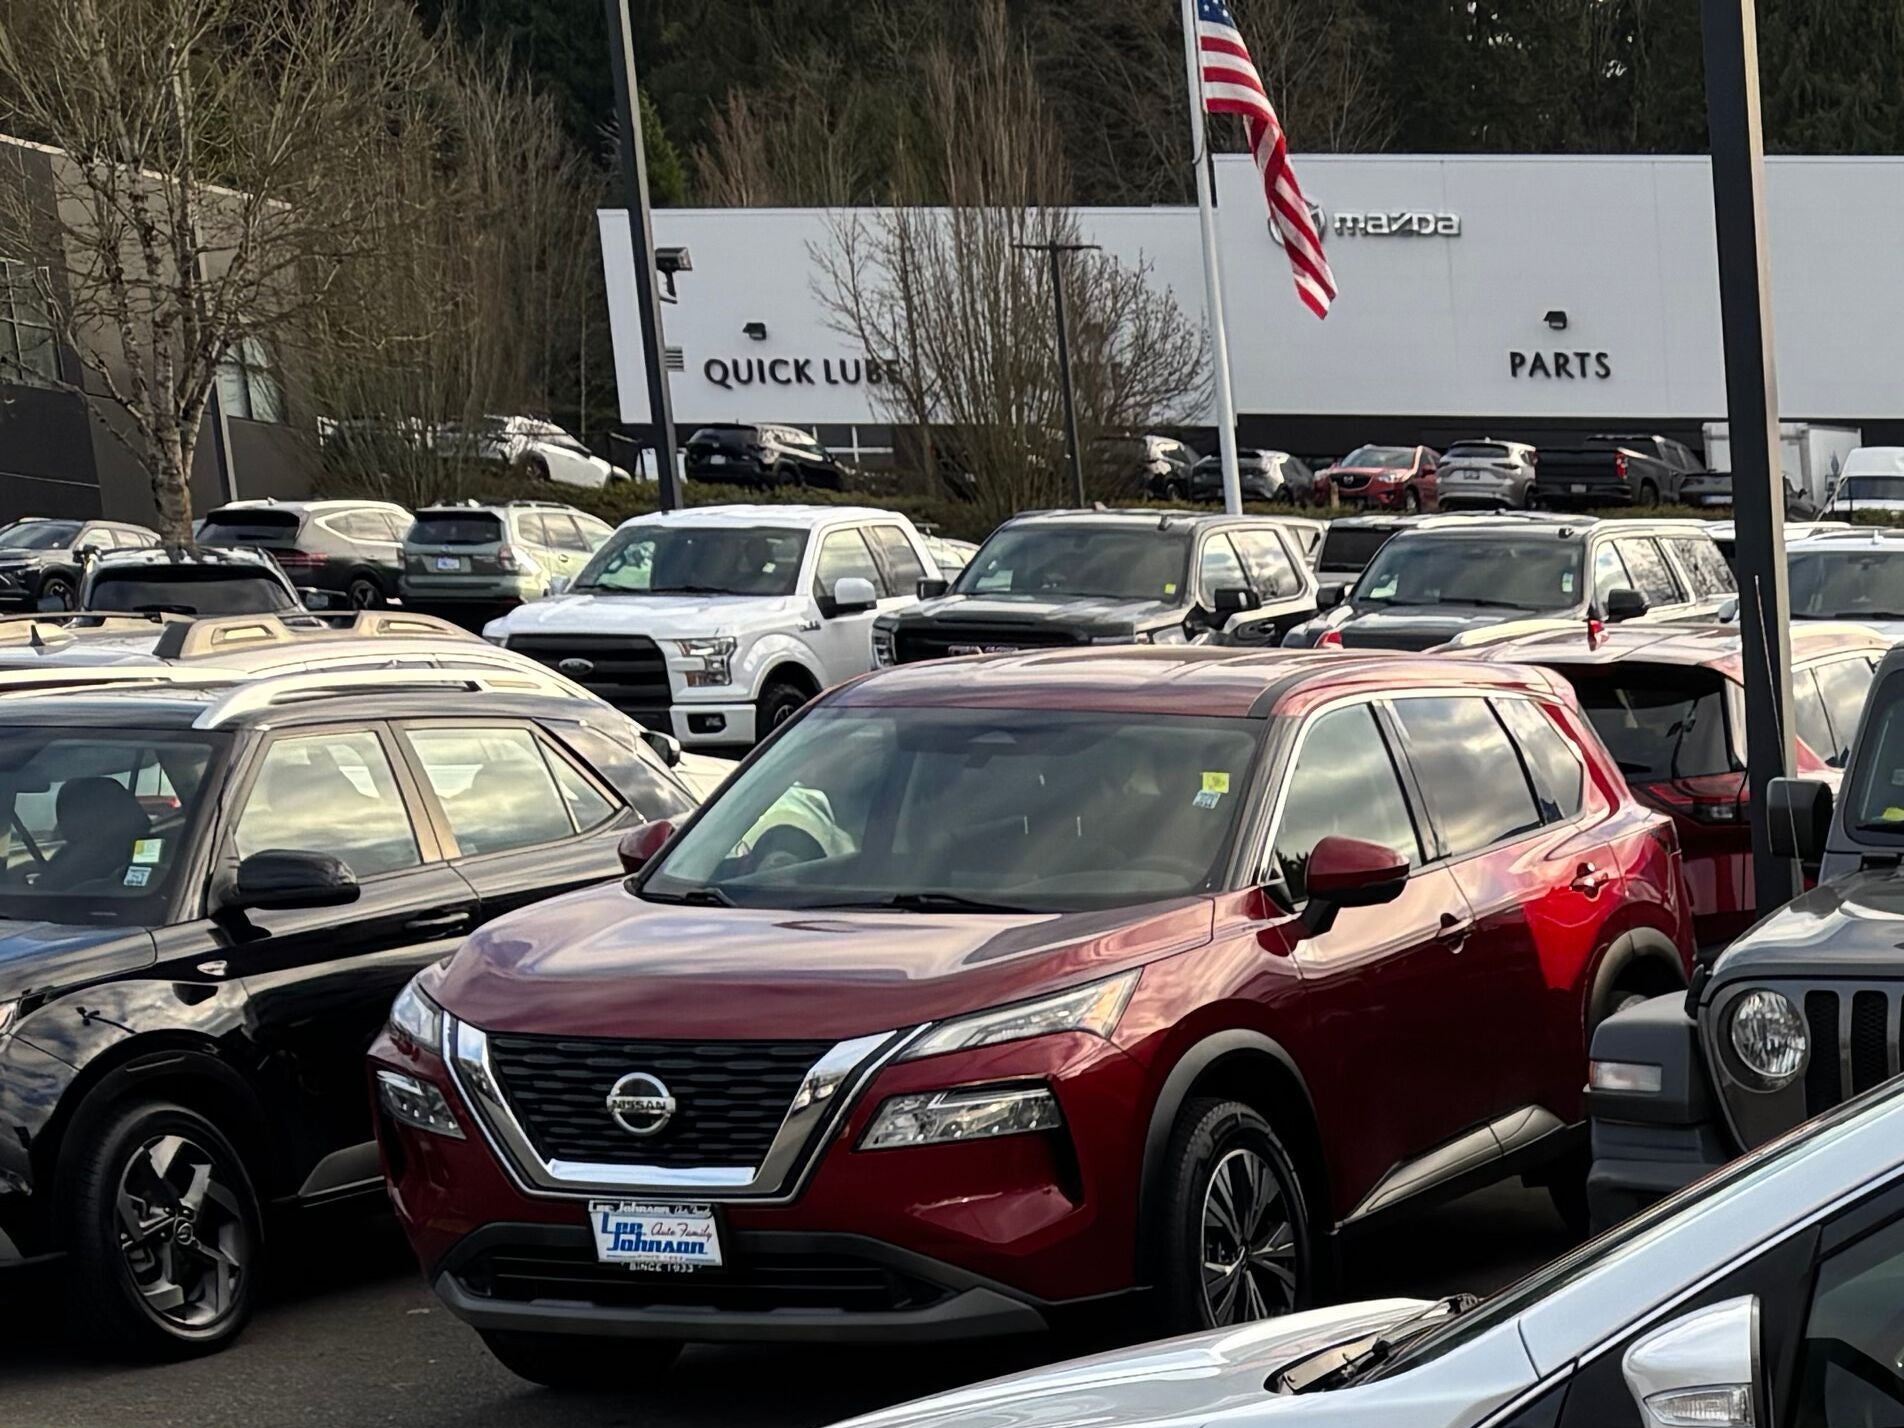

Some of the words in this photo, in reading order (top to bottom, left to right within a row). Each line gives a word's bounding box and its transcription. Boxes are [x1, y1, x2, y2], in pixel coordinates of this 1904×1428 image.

[1333, 212, 1462, 236] mazda
[703, 358, 816, 391] QUICK
[1509, 351, 1612, 380] PARTS
[611, 1099, 667, 1110] NISSAN
[601, 1212, 647, 1236] Lee
[606, 1231, 709, 1255] Johnson
